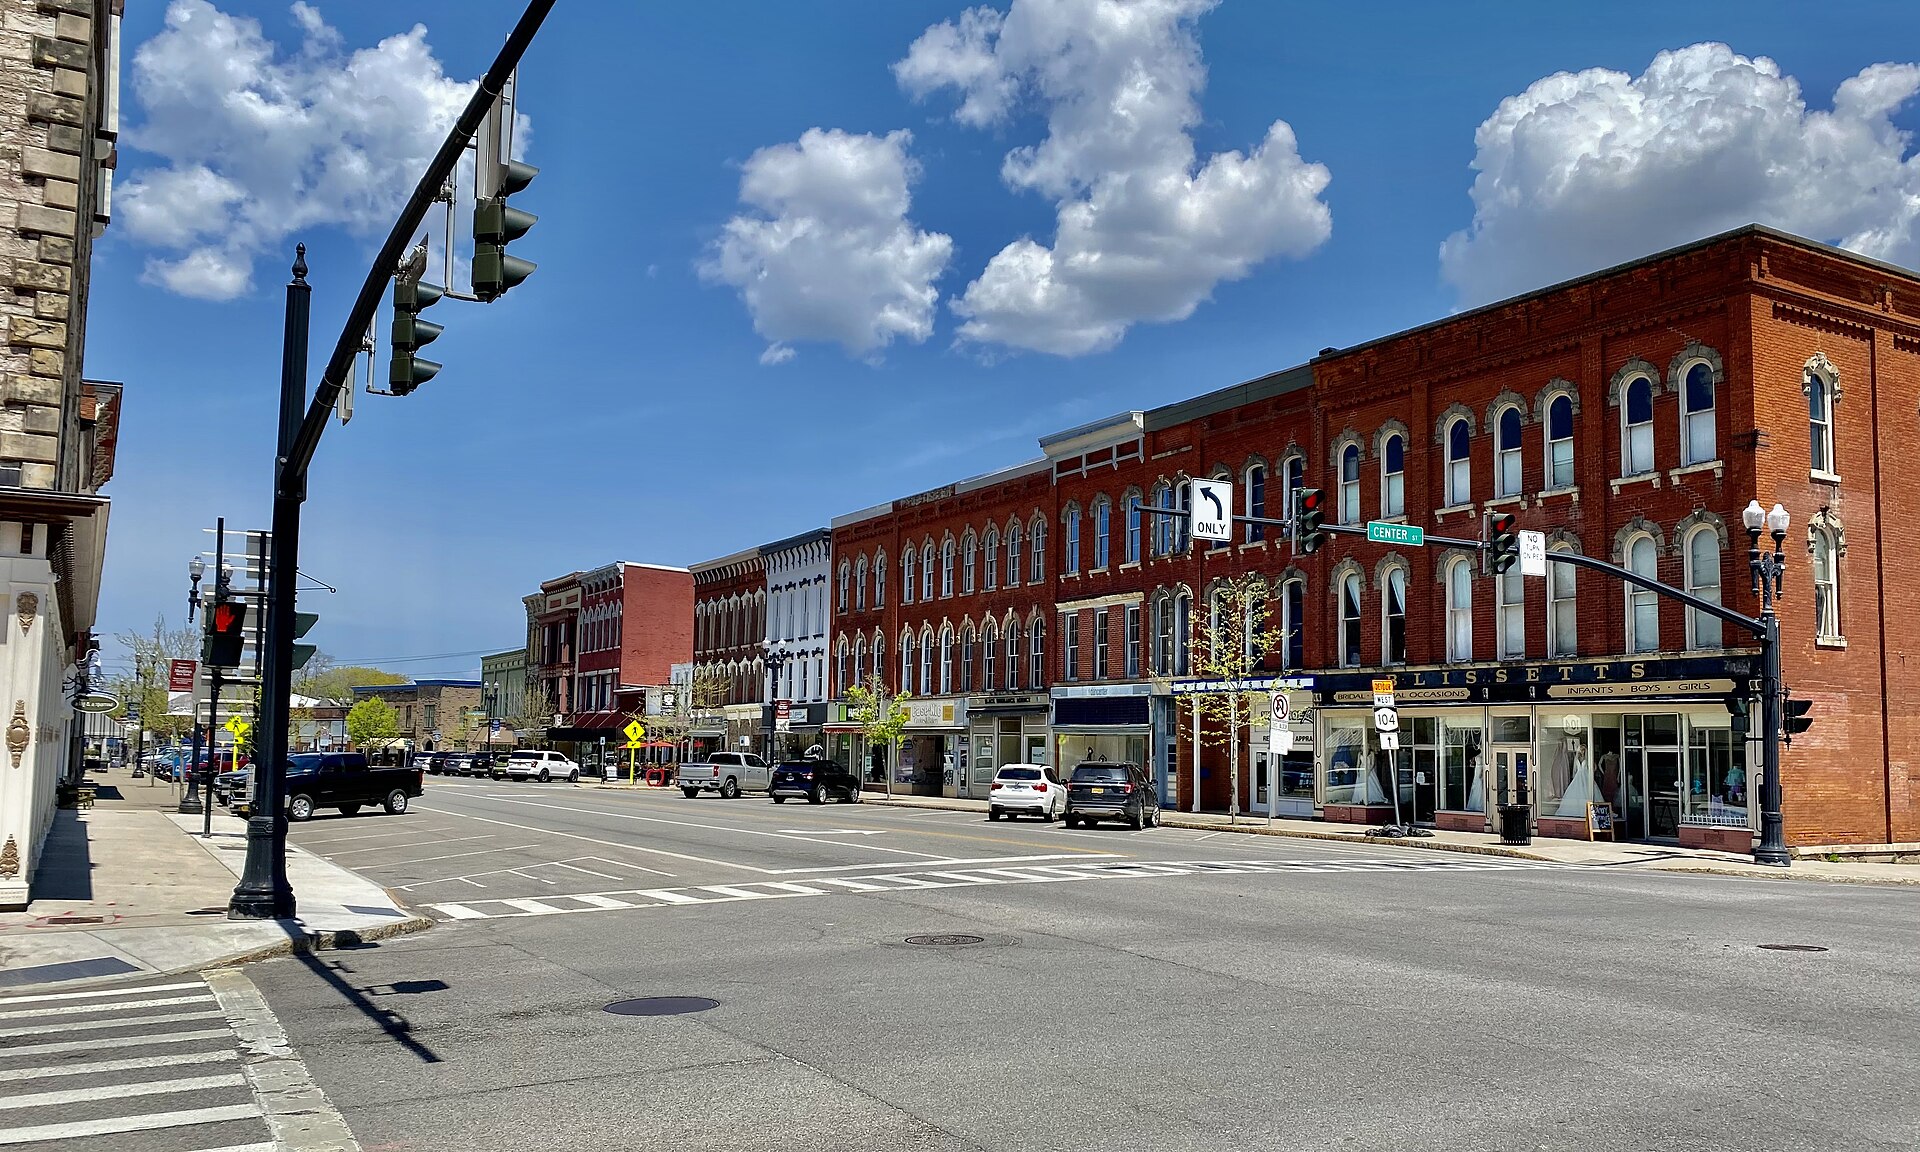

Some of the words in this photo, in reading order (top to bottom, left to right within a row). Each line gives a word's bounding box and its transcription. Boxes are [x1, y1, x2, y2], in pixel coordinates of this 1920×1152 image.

[1197, 521, 1226, 535] ONLY
[1373, 526, 1408, 541] CENTER
[1527, 534, 1538, 543] NO
[1386, 663, 1646, 686] BLISSETTS
[1374, 683, 1391, 691] DETOUR
[1567, 685, 1614, 695] INFANTS
[1630, 684, 1661, 693] BOYS
[1678, 682, 1711, 691] GIRLS
[1337, 693, 1365, 701] BRIDAL
[1409, 690, 1466, 699] OCCASIONS
[1378, 714, 1396, 726] 104
